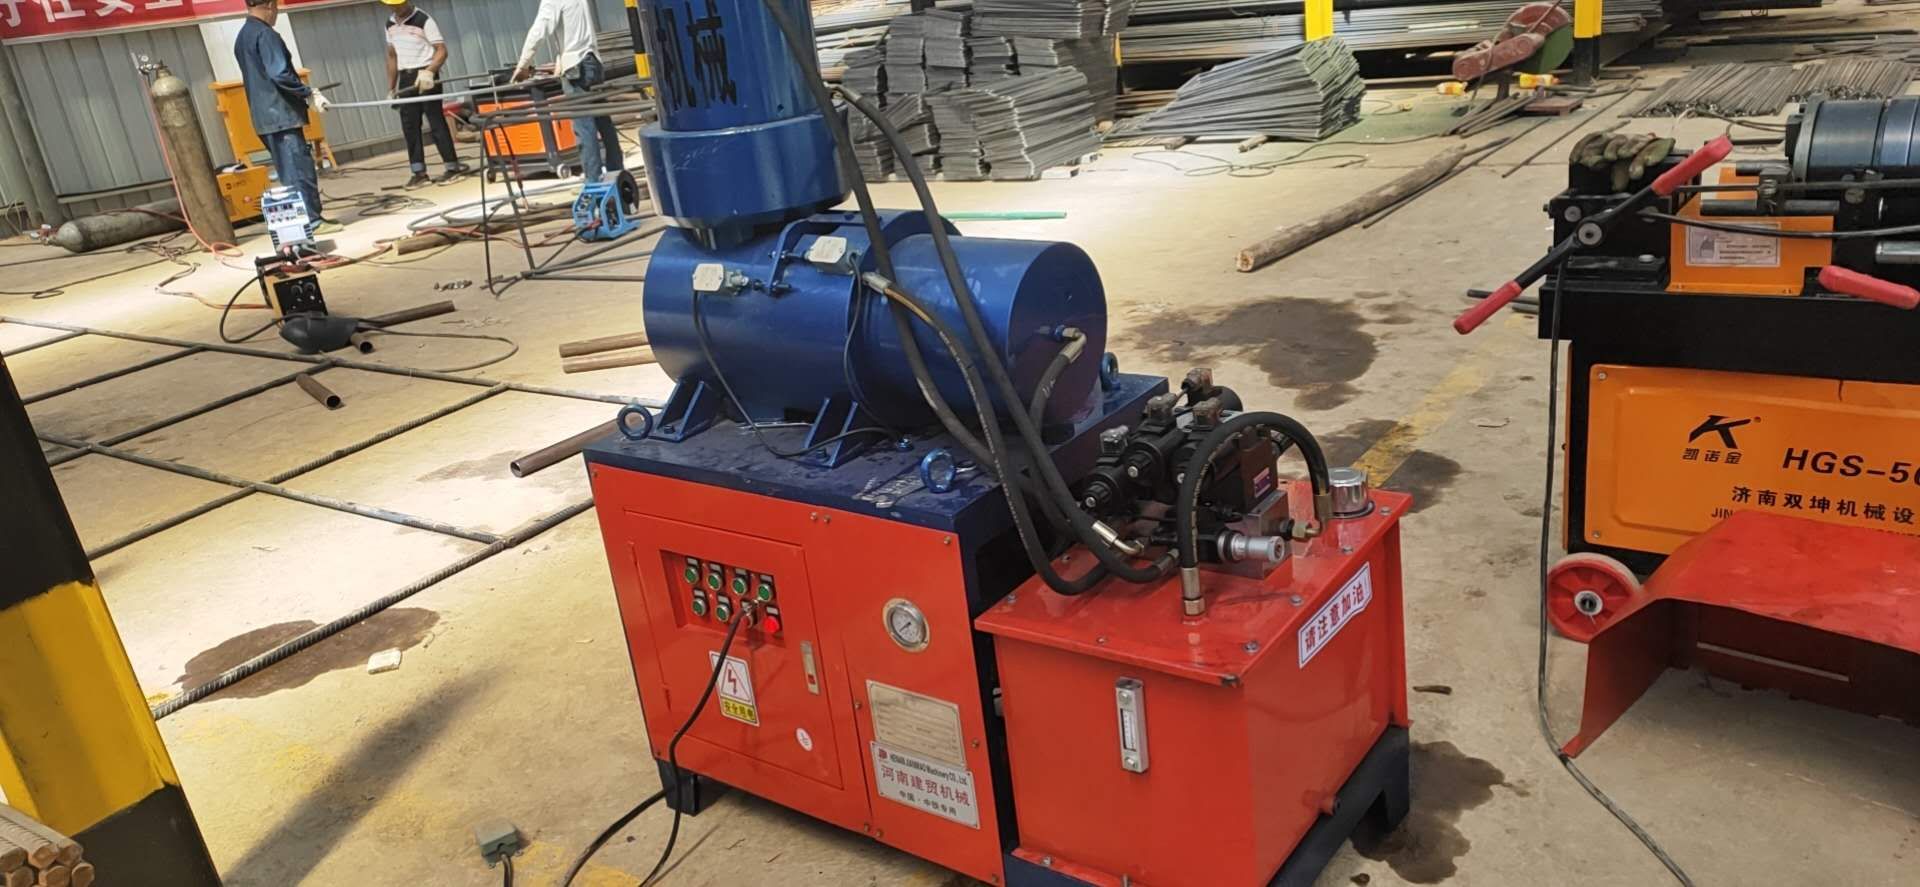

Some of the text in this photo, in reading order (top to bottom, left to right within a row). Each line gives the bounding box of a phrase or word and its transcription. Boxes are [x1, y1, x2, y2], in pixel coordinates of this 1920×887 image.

[1682, 448, 1742, 465] 凯诺金
[1732, 485, 1915, 525] 济南双坤机械设
[1305, 583, 1364, 653] 请注意加油
[881, 765, 970, 806] 河南建贸机械
